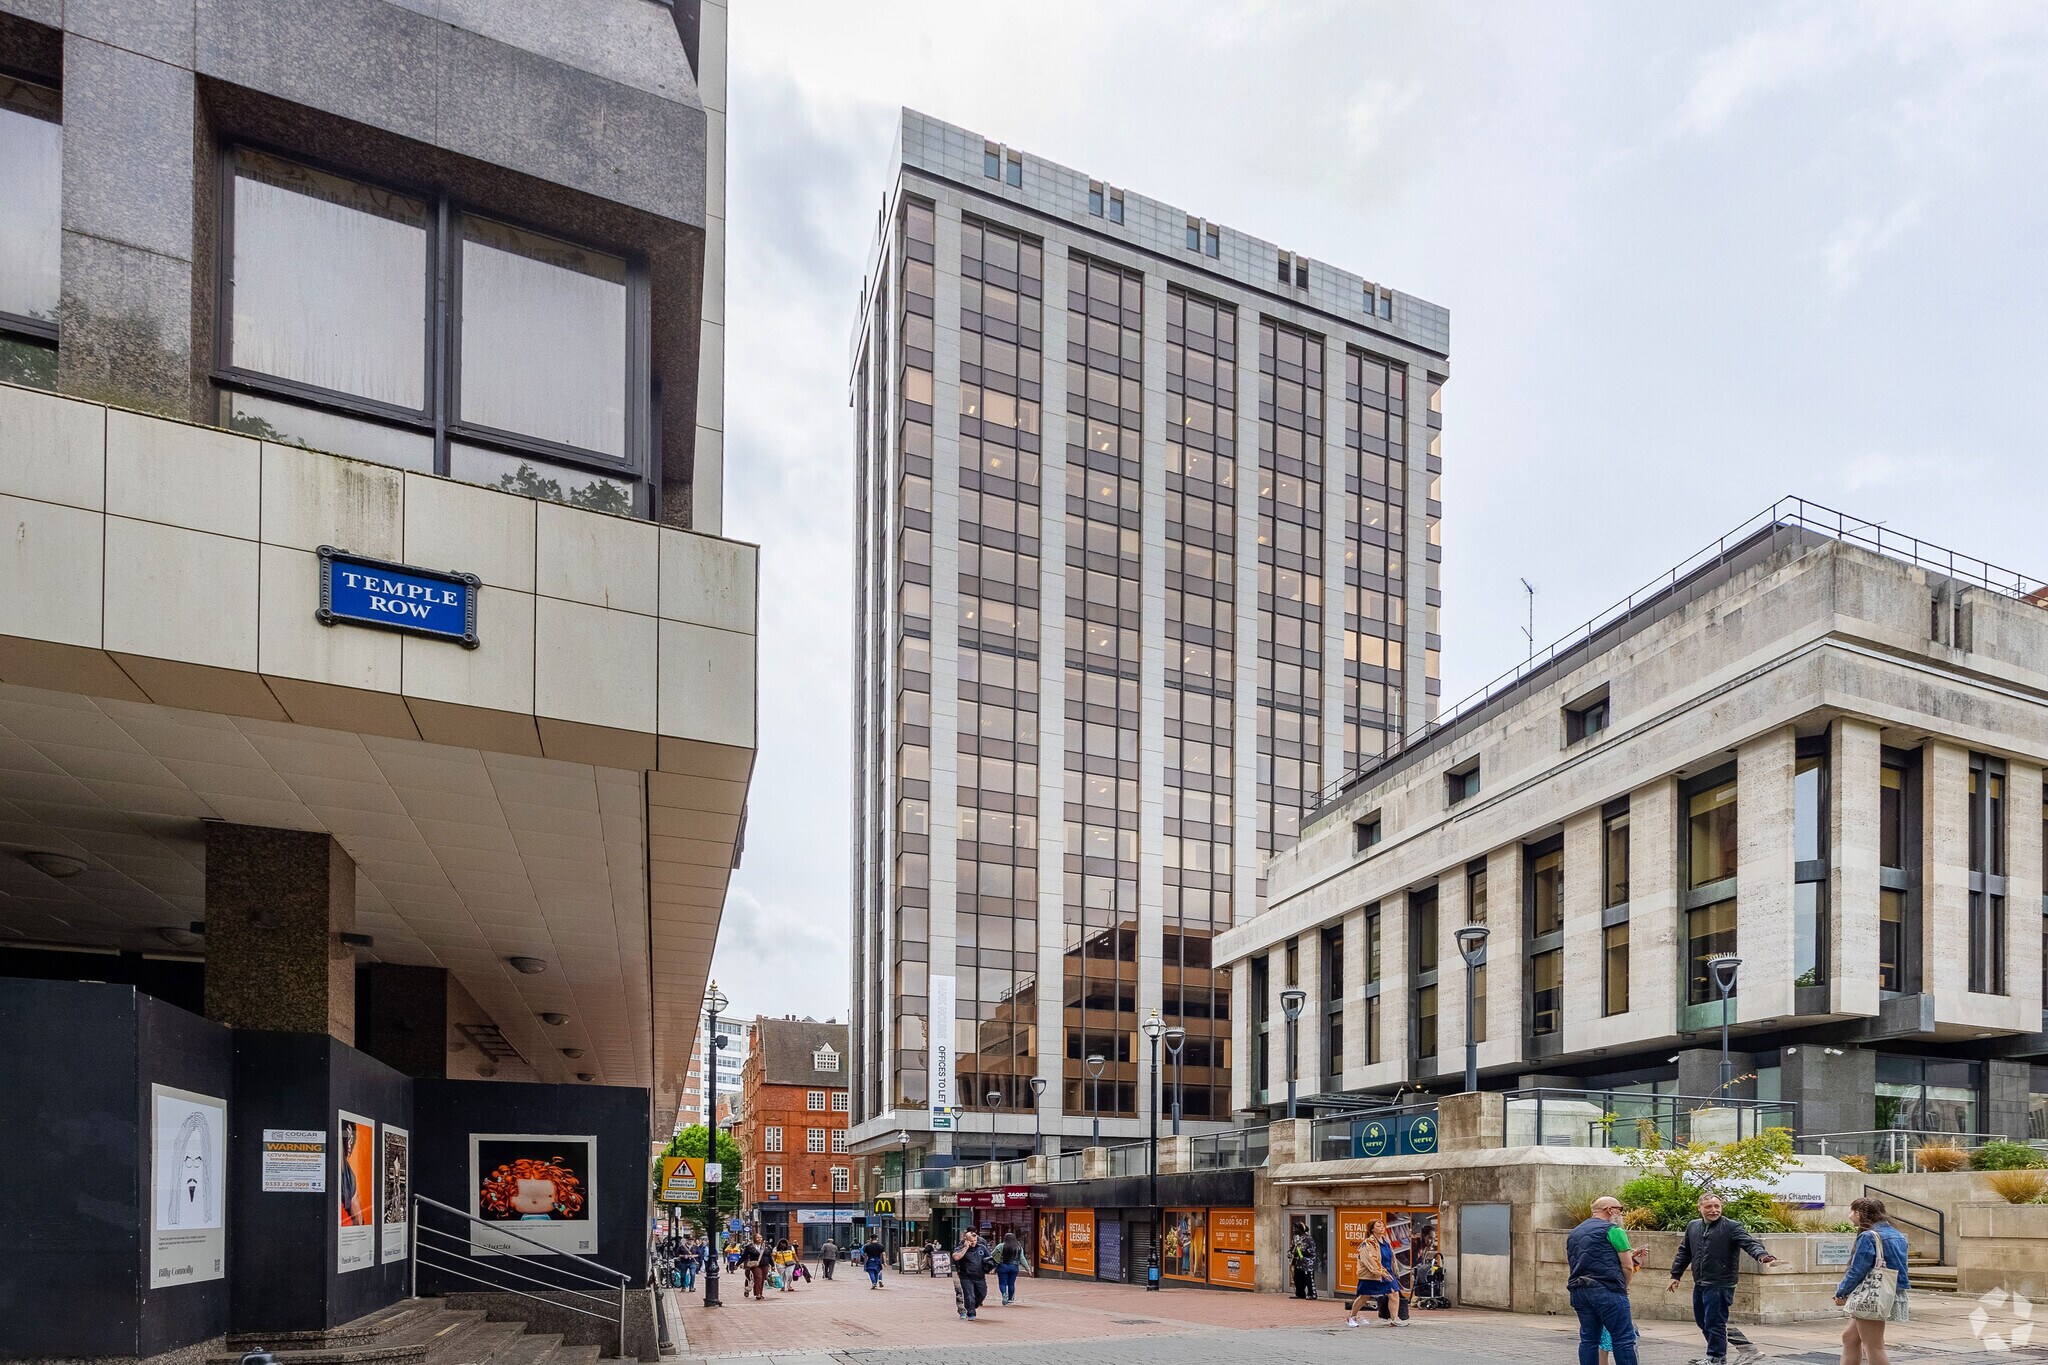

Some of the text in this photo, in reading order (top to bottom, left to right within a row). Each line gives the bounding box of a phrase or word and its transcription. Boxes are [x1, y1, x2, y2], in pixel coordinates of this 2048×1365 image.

[342, 571, 458, 607] TEMPLE
[369, 595, 432, 619] ROW
[938, 1045, 946, 1077] OFFICES
[938, 1078, 946, 1088] TO
[938, 1089, 946, 1104] LET
[1413, 1136, 1433, 1144] serve
[266, 1143, 322, 1152] WARNING
[1788, 1192, 1821, 1201] Chambers
[1219, 1218, 1235, 1226] 20,000
[1235, 1218, 1243, 1226] SQ
[1069, 1223, 1091, 1232] RETAIL &
[1344, 1223, 1367, 1232] RETAIL
[1069, 1233, 1090, 1242] LEISURE
[1345, 1232, 1365, 1240] LEISU
[158, 1265, 194, 1278] Billy Connolly
